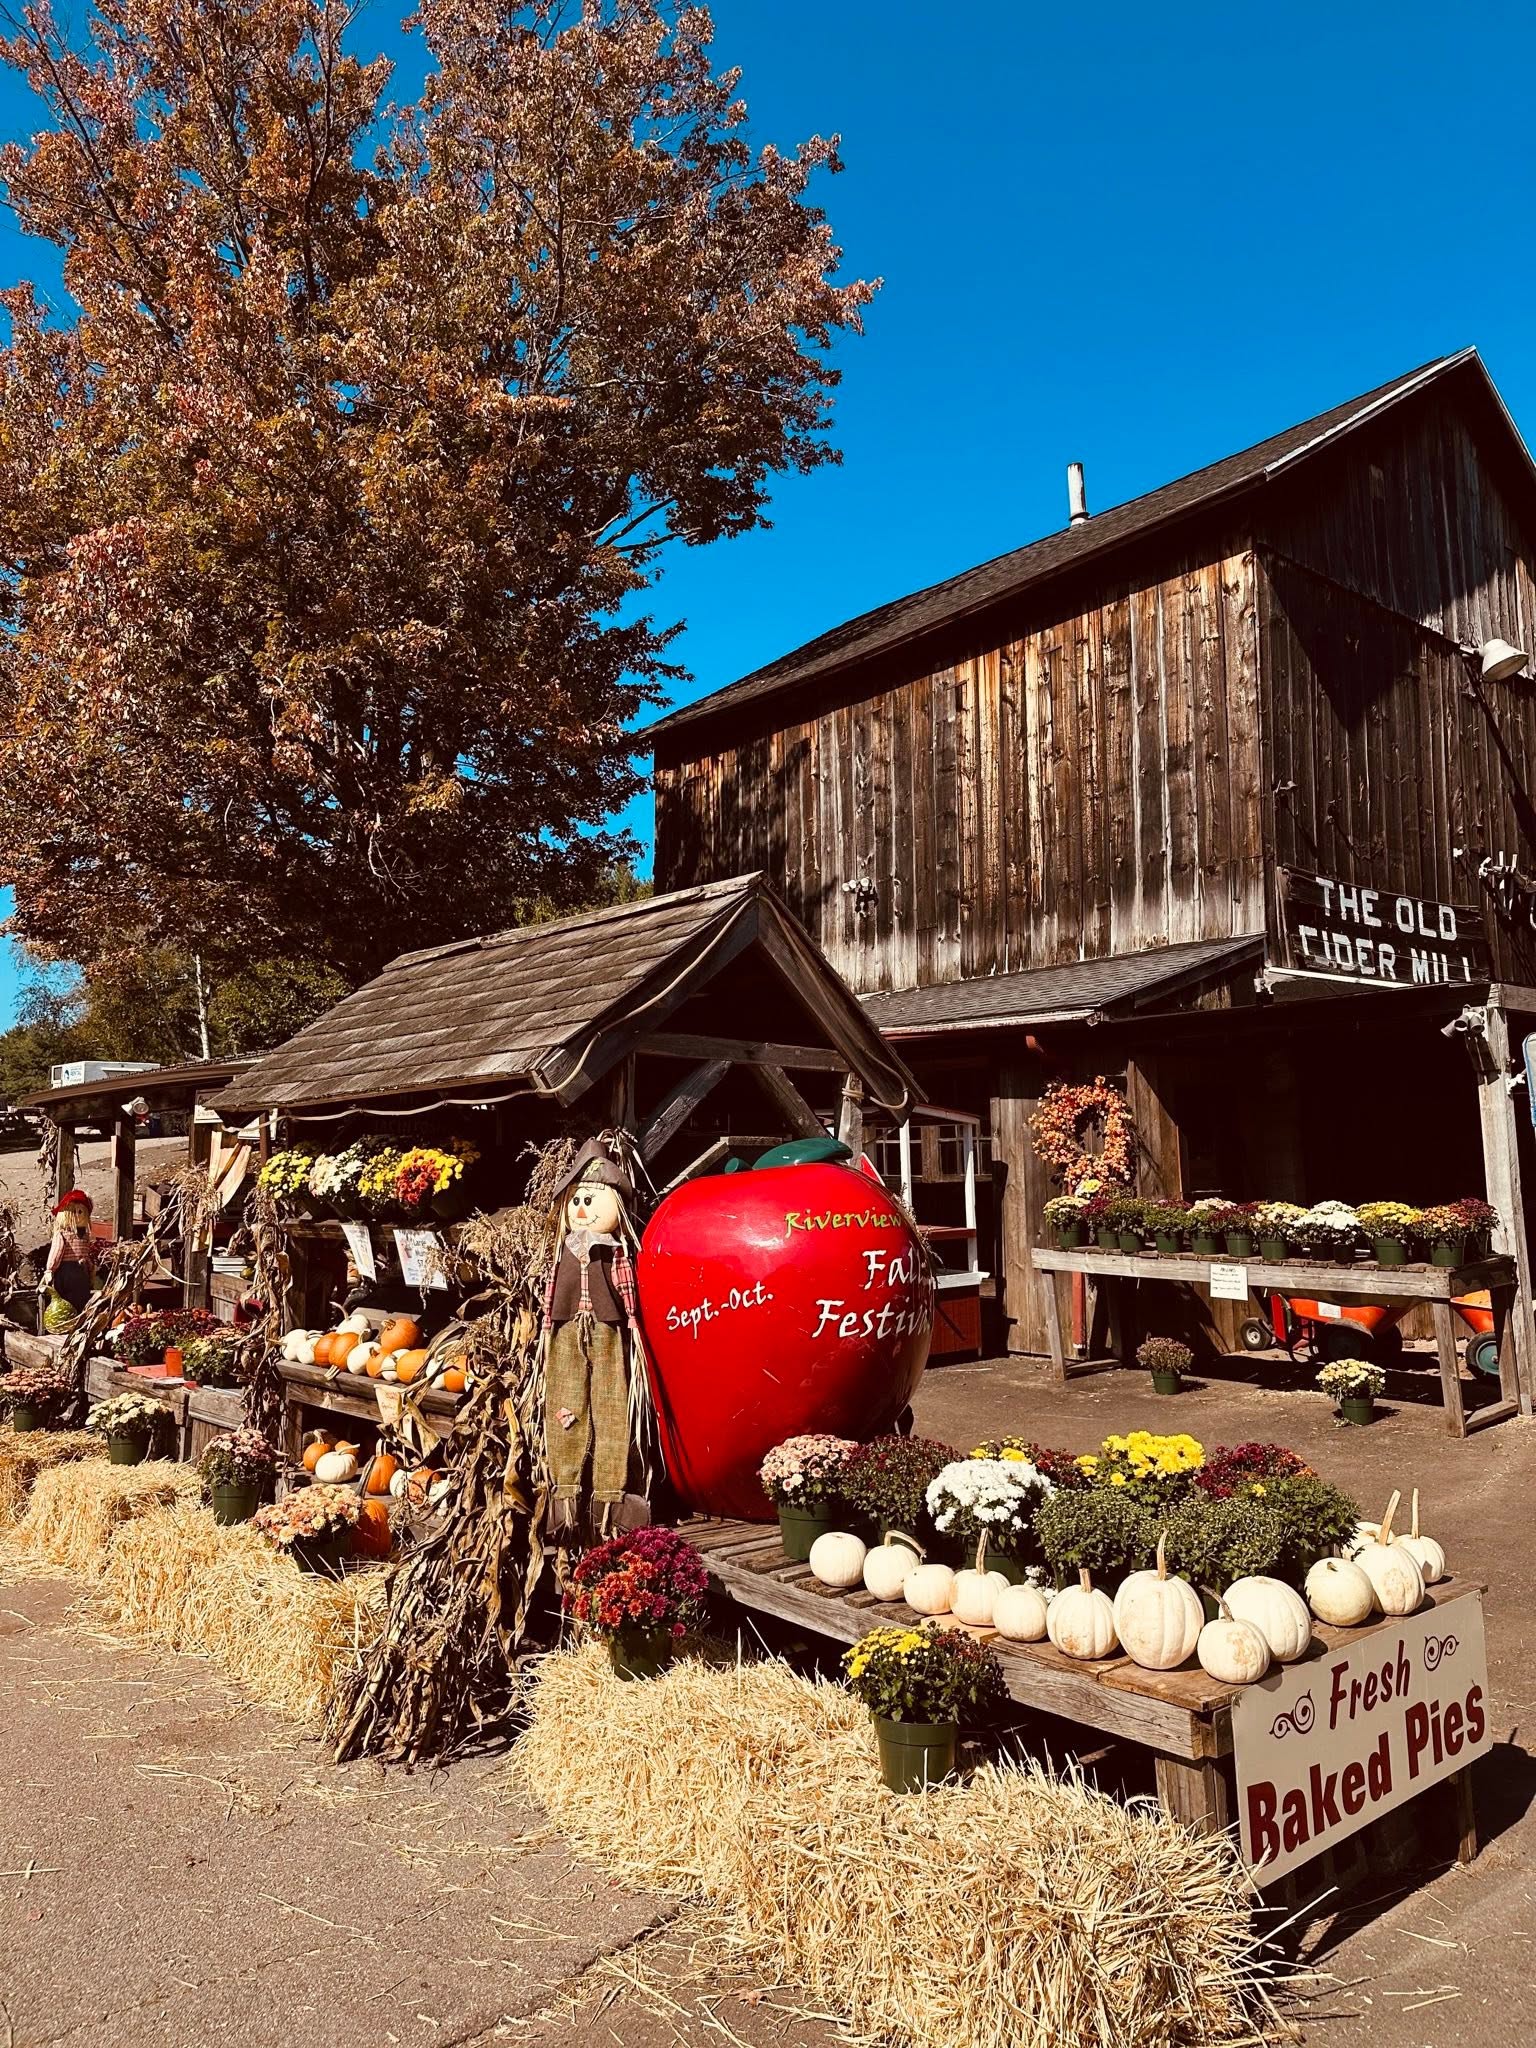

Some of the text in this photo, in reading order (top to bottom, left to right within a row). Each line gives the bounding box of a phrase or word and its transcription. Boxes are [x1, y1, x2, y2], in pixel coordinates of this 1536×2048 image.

[1315, 876, 1457, 941] THE OLD
[1298, 924, 1397, 980] CIDER
[784, 1206, 902, 1238] Riverview
[862, 1246, 924, 1290] Fall
[1329, 1639, 1411, 1730] Fresh
[1246, 1684, 1485, 1867] Baked Pies
